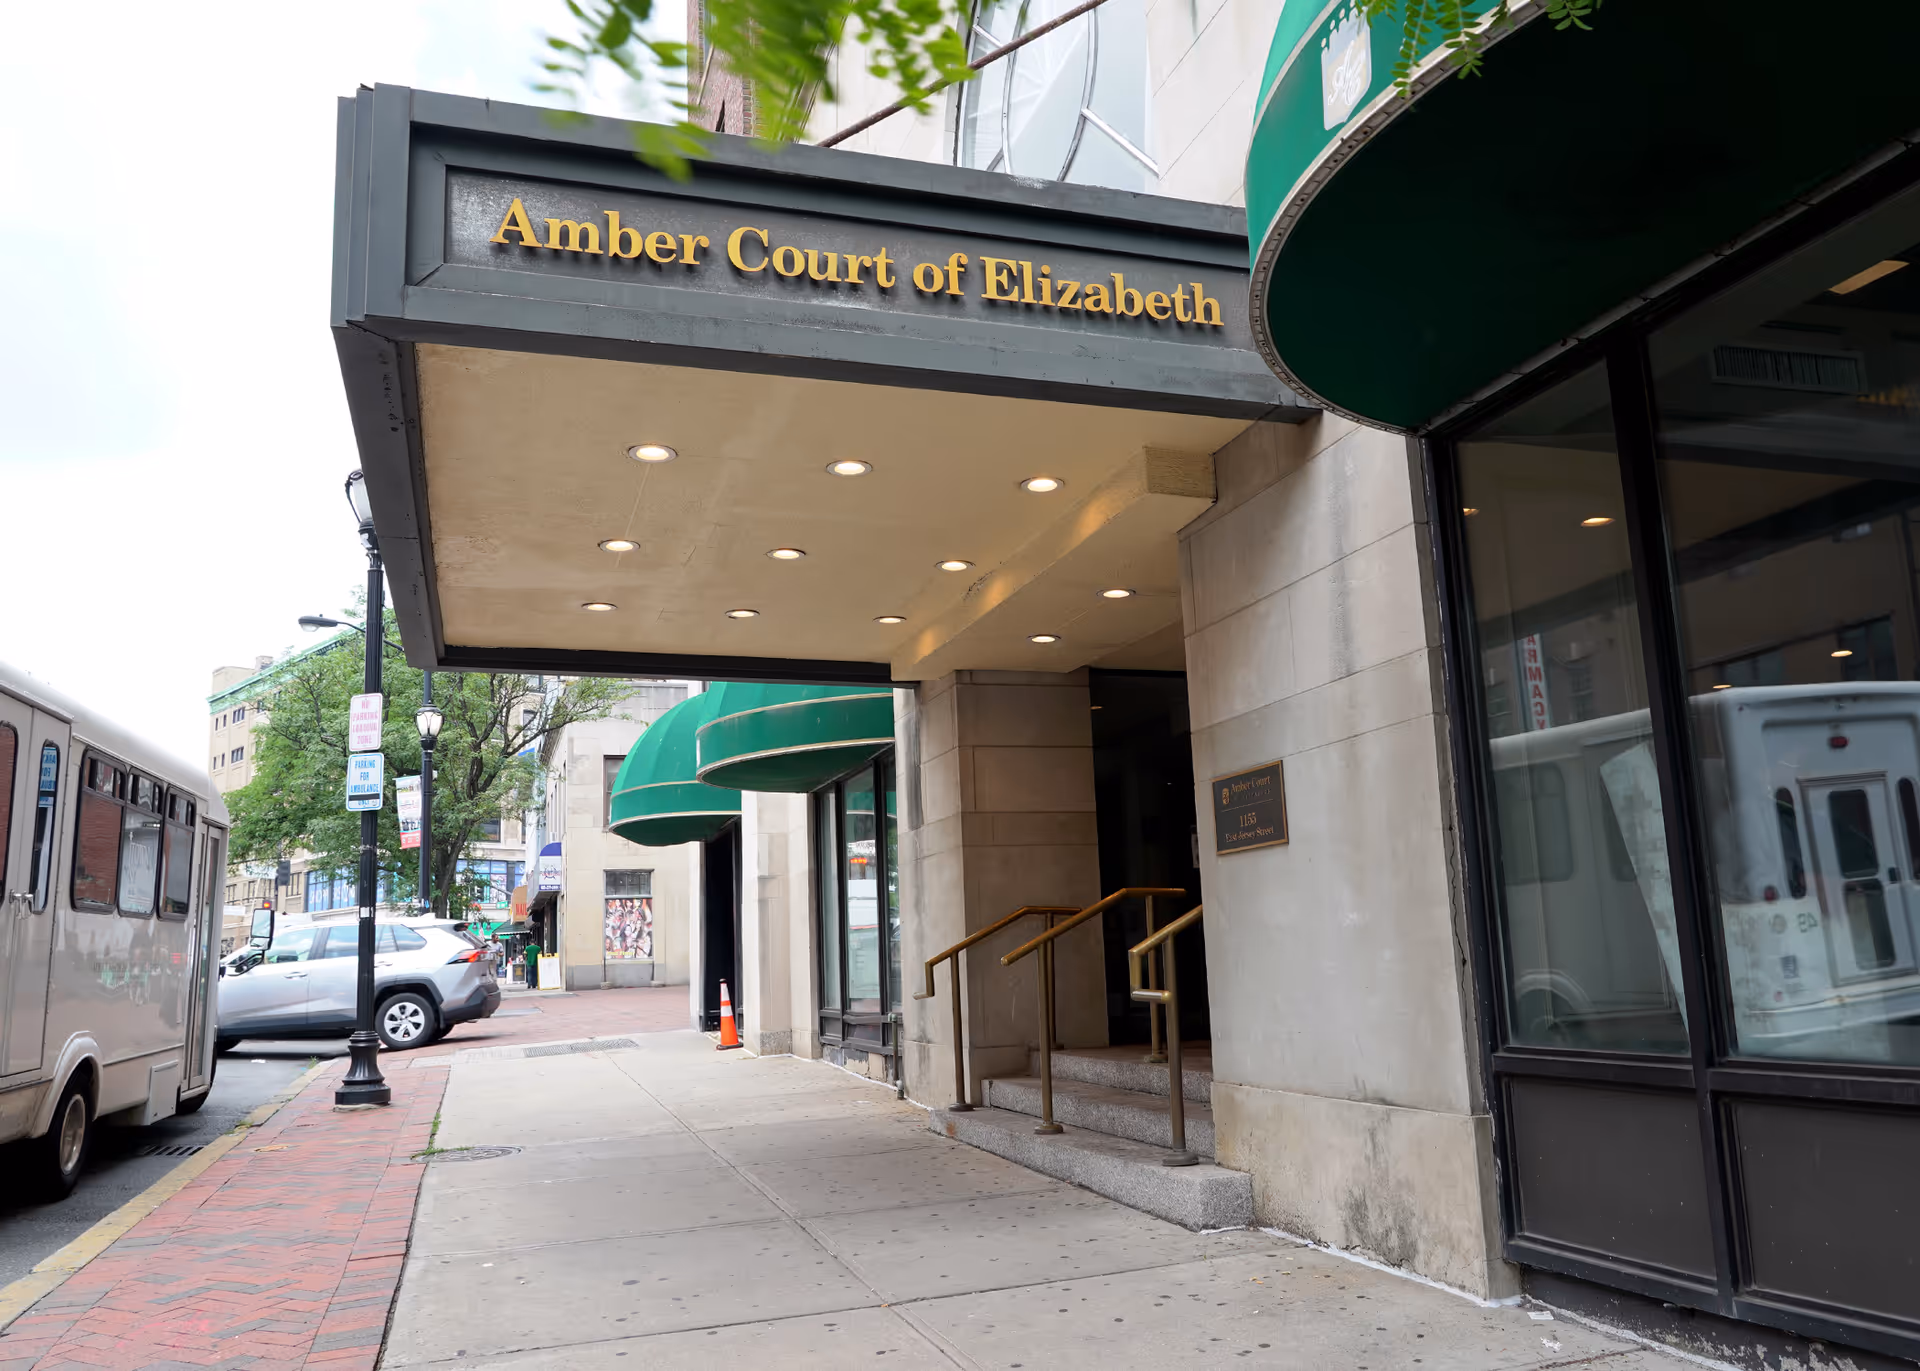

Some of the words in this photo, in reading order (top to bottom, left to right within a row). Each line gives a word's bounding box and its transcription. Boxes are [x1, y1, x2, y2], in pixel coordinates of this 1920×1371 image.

[491, 199, 709, 264] Amber
[728, 227, 895, 288] Court
[913, 253, 968, 295] of
[980, 257, 1223, 325] Elizabeth
[352, 712, 378, 722] PARKING
[357, 735, 372, 744] ZONE
[354, 760, 376, 769] PARKING
[360, 772, 369, 781] FOR
[350, 783, 379, 793] AMBULANCE
[1231, 781, 1250, 793] Amber
[1252, 776, 1271, 788] Court
[1240, 812, 1257, 827] 1155
[1256, 826, 1274, 837] Street
